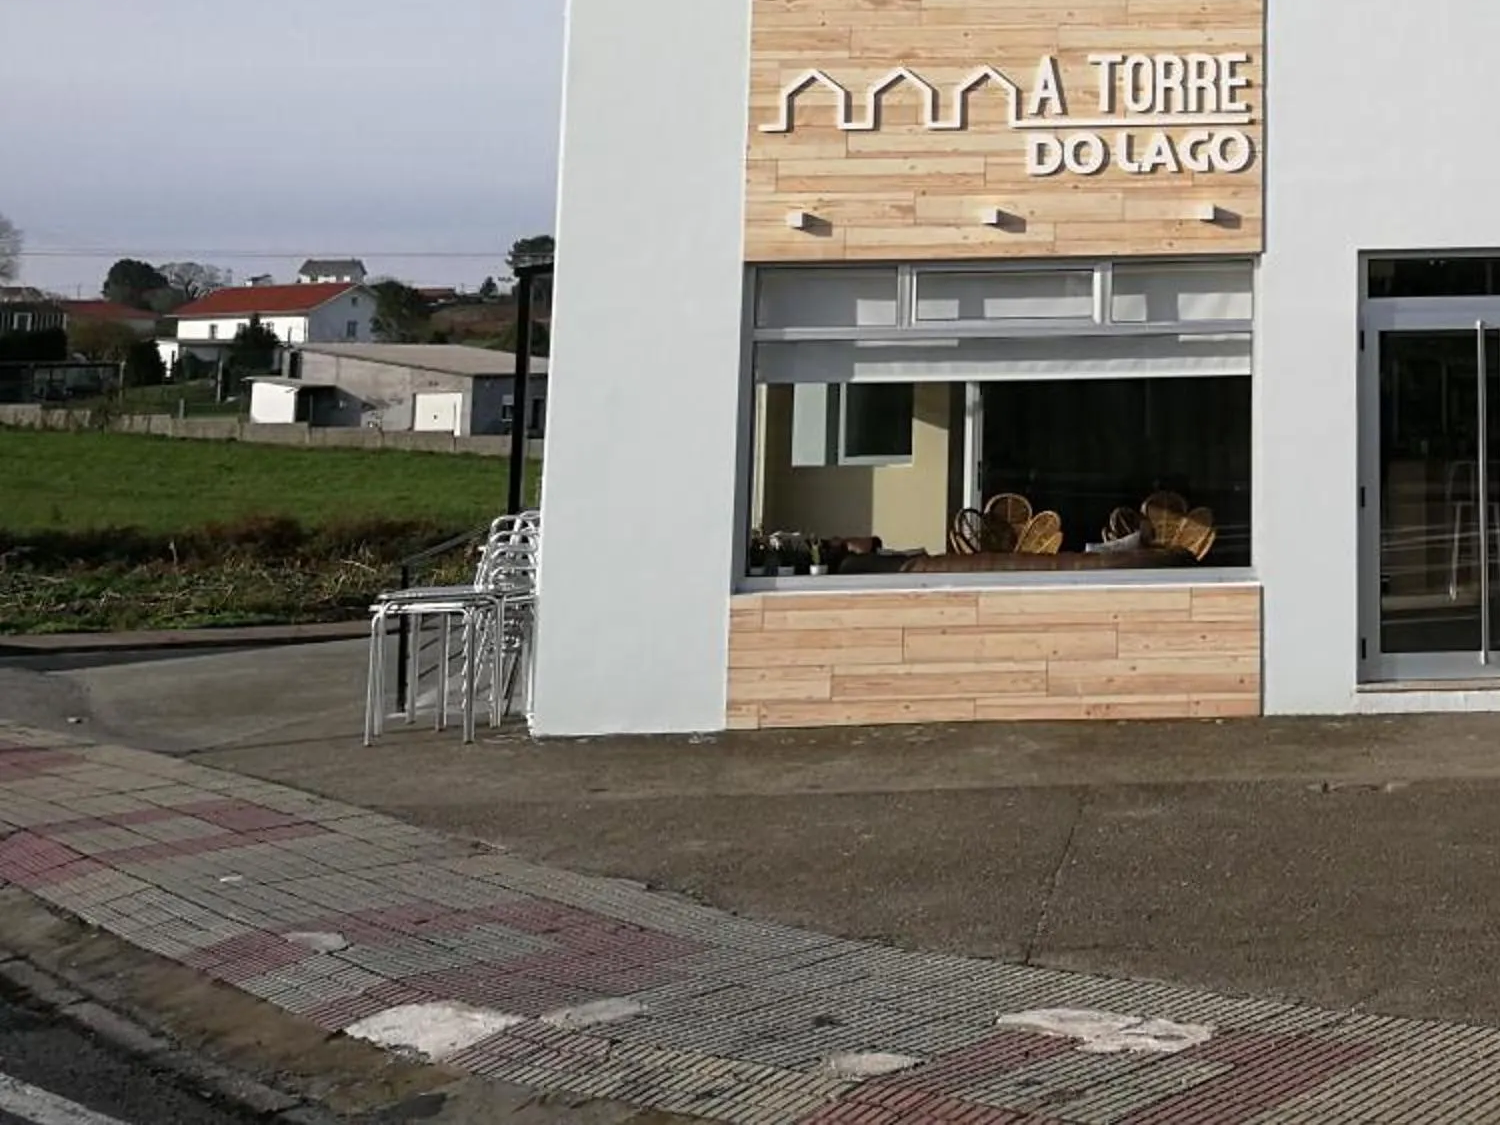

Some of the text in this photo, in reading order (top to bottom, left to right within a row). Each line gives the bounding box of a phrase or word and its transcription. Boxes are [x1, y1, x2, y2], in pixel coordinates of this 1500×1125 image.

[1028, 53, 1250, 115] A TORRE
[1026, 128, 1251, 175] DO LAGO
